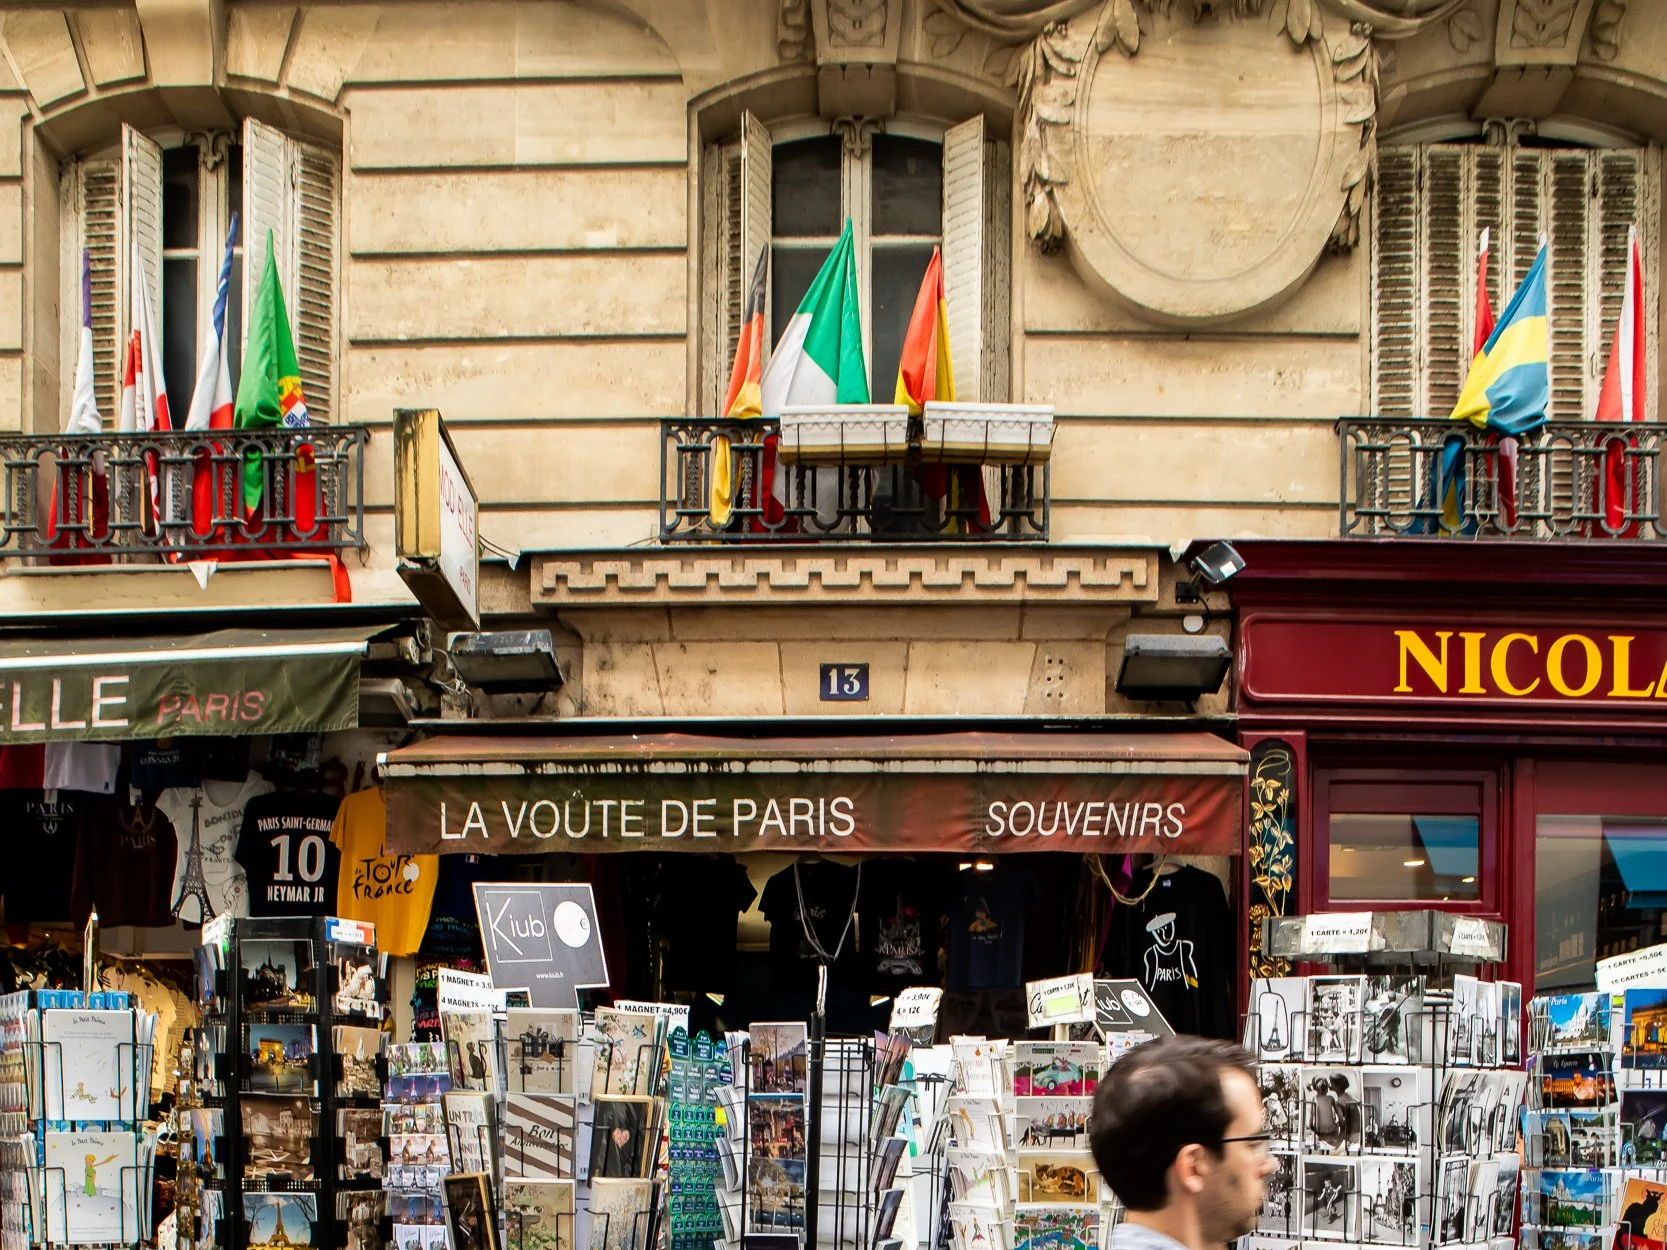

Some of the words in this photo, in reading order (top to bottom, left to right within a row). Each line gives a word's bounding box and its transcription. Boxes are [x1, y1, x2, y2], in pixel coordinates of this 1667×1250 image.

[1393, 630, 1667, 698] NICOL
[828, 667, 861, 696] 13
[157, 690, 265, 726] PARIS
[26, 801, 74, 815] PARIS
[257, 816, 279, 832] PARIS
[440, 801, 489, 840] LA
[661, 799, 717, 838] DE
[733, 797, 856, 837] PARIS
[985, 800, 1187, 838] SOUVENIRS
[120, 835, 156, 848] PARIS
[270, 834, 326, 883] 10
[267, 886, 310, 903] NEYMAR
[313, 886, 325, 903] JR
[486, 897, 545, 956] Kiub
[1316, 929, 1341, 937] CARTE
[1613, 957, 1637, 969] CARTE
[446, 974, 474, 987] MAGNET
[1156, 967, 1182, 982] PARIS
[1620, 970, 1649, 983] CARTES
[447, 997, 479, 1008] MAGNETS
[1550, 996, 1568, 1007] Paris
[623, 1004, 660, 1015] MAGNET
[448, 1110, 461, 1122] UN
[527, 1124, 555, 1139] Bon
